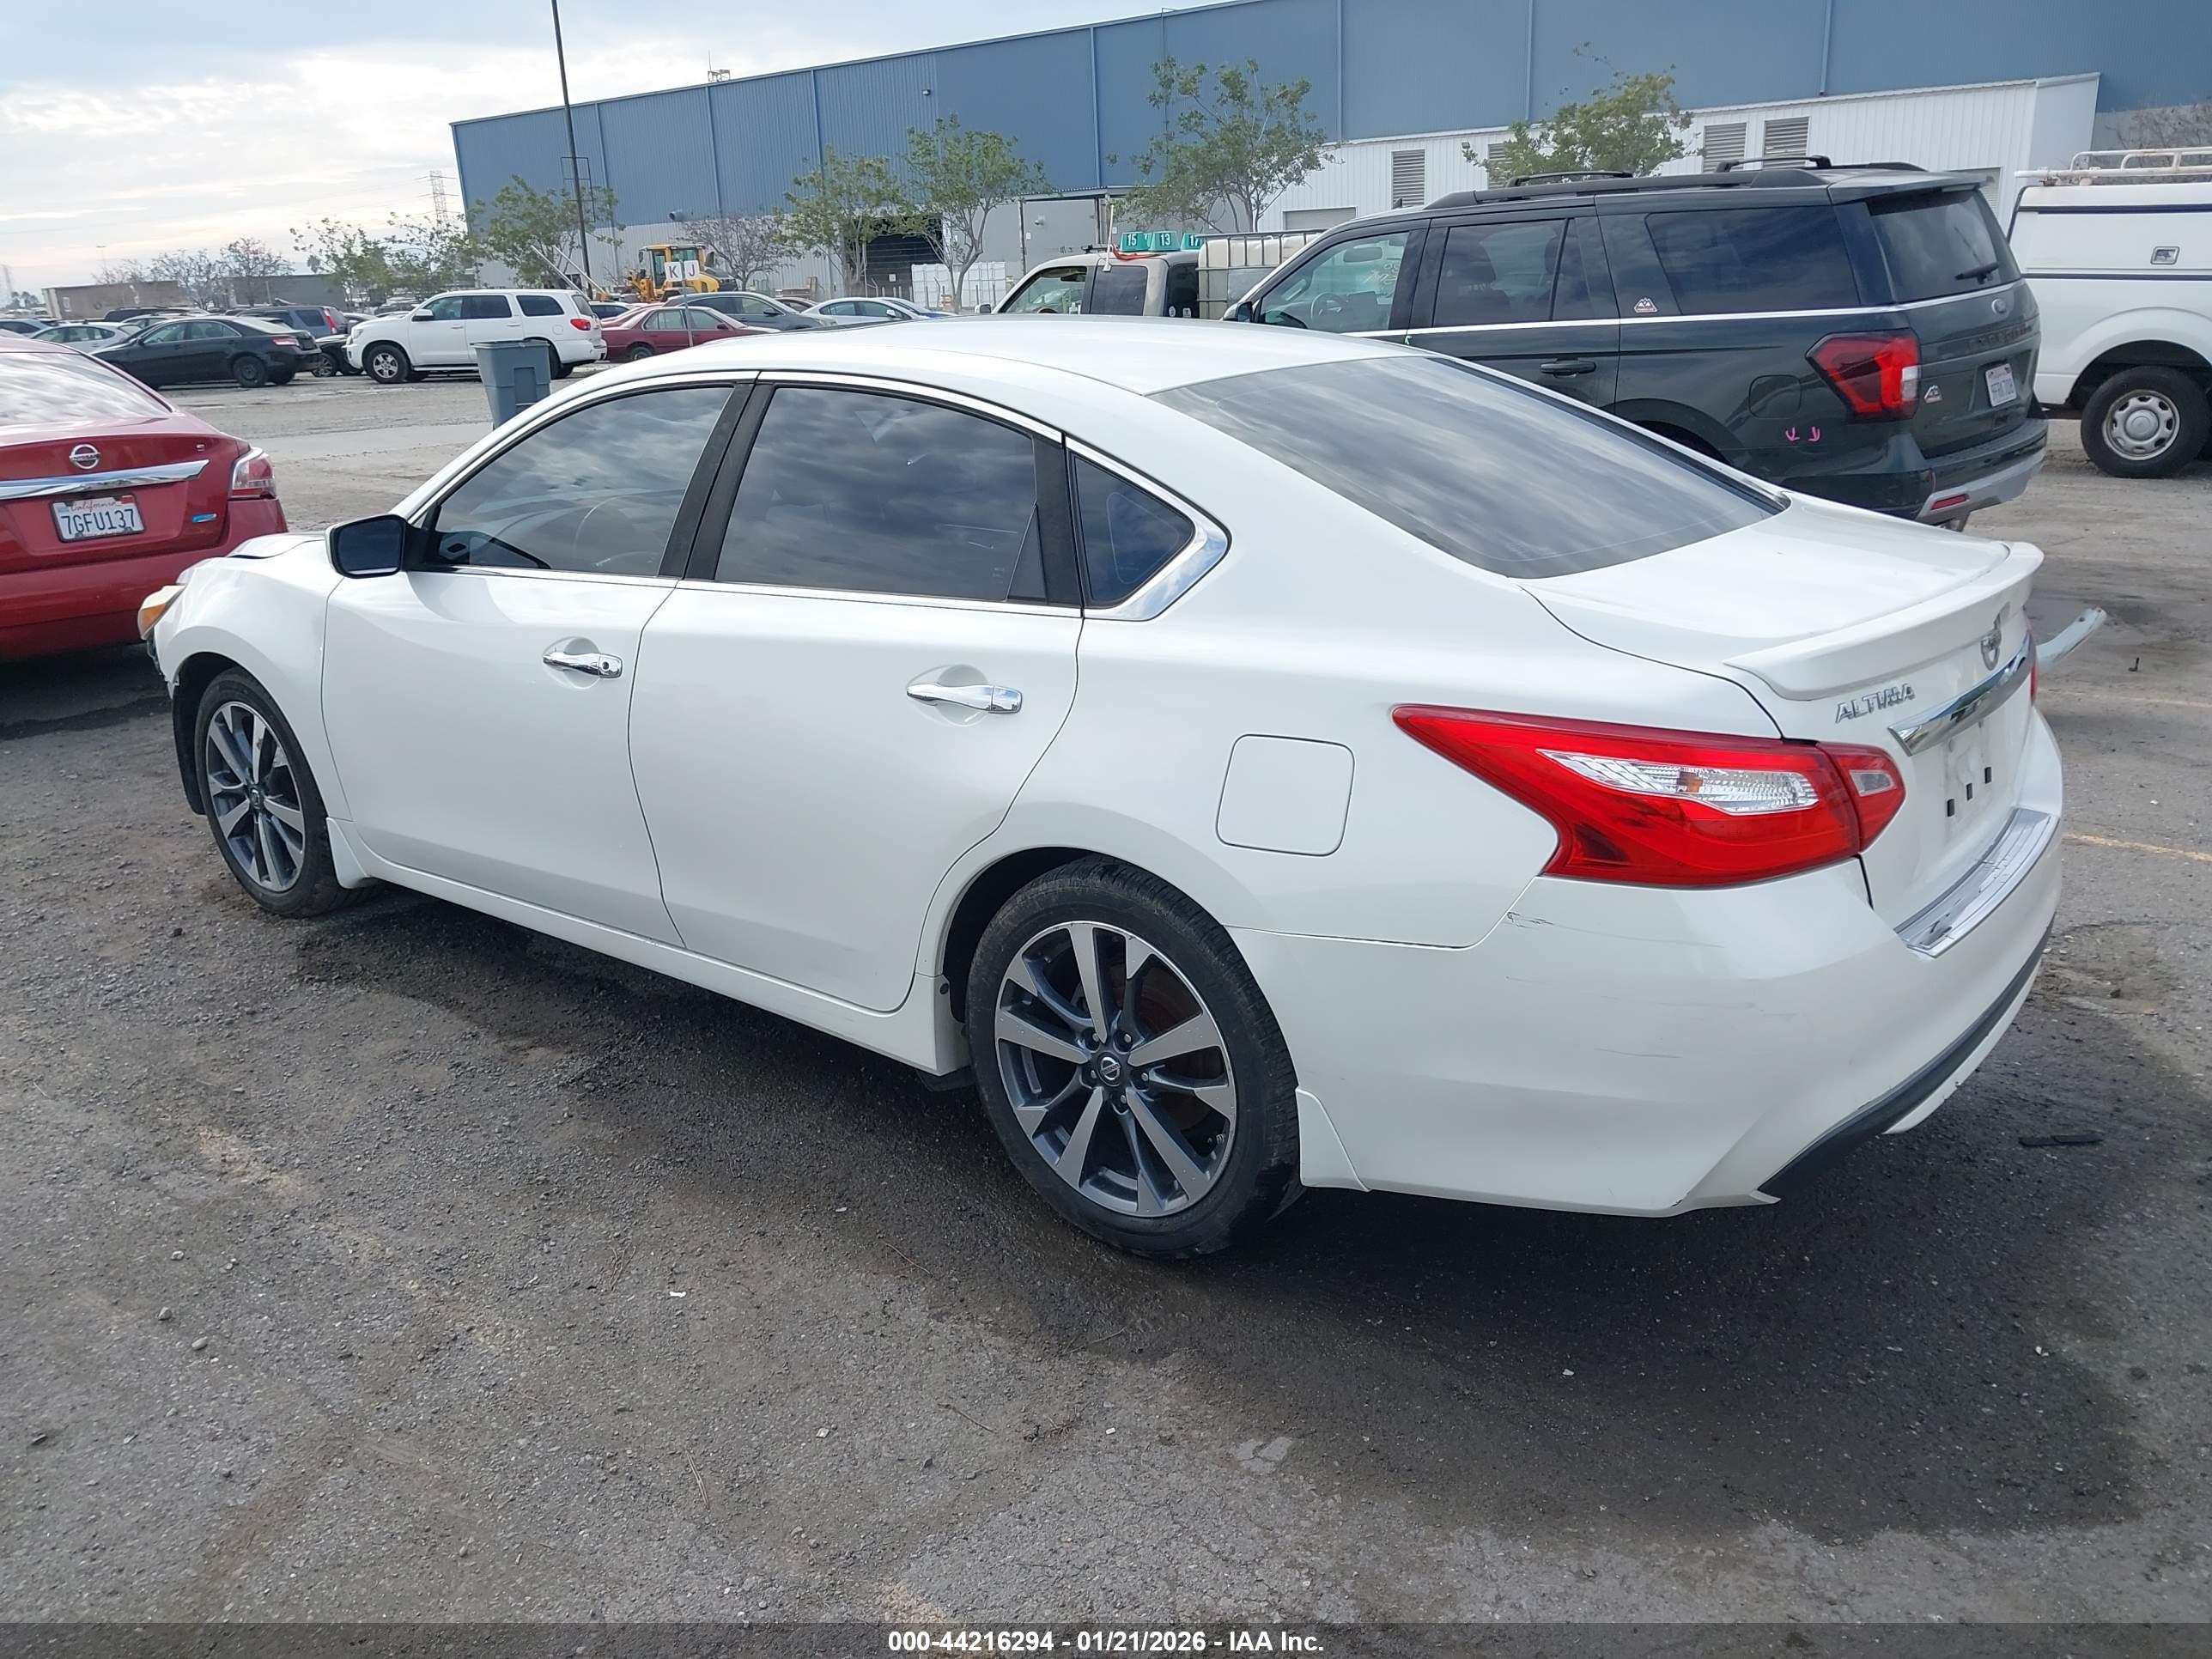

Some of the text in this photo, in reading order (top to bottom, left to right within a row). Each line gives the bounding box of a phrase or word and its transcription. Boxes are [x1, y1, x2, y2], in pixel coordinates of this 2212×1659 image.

[1127, 233, 1138, 246] 15
[1161, 233, 1171, 246] 13
[668, 265, 679, 278] K
[689, 264, 696, 276] J
[70, 500, 117, 513] California
[60, 508, 135, 535] 7GFU137
[1834, 683, 1916, 723] ALTIMA
